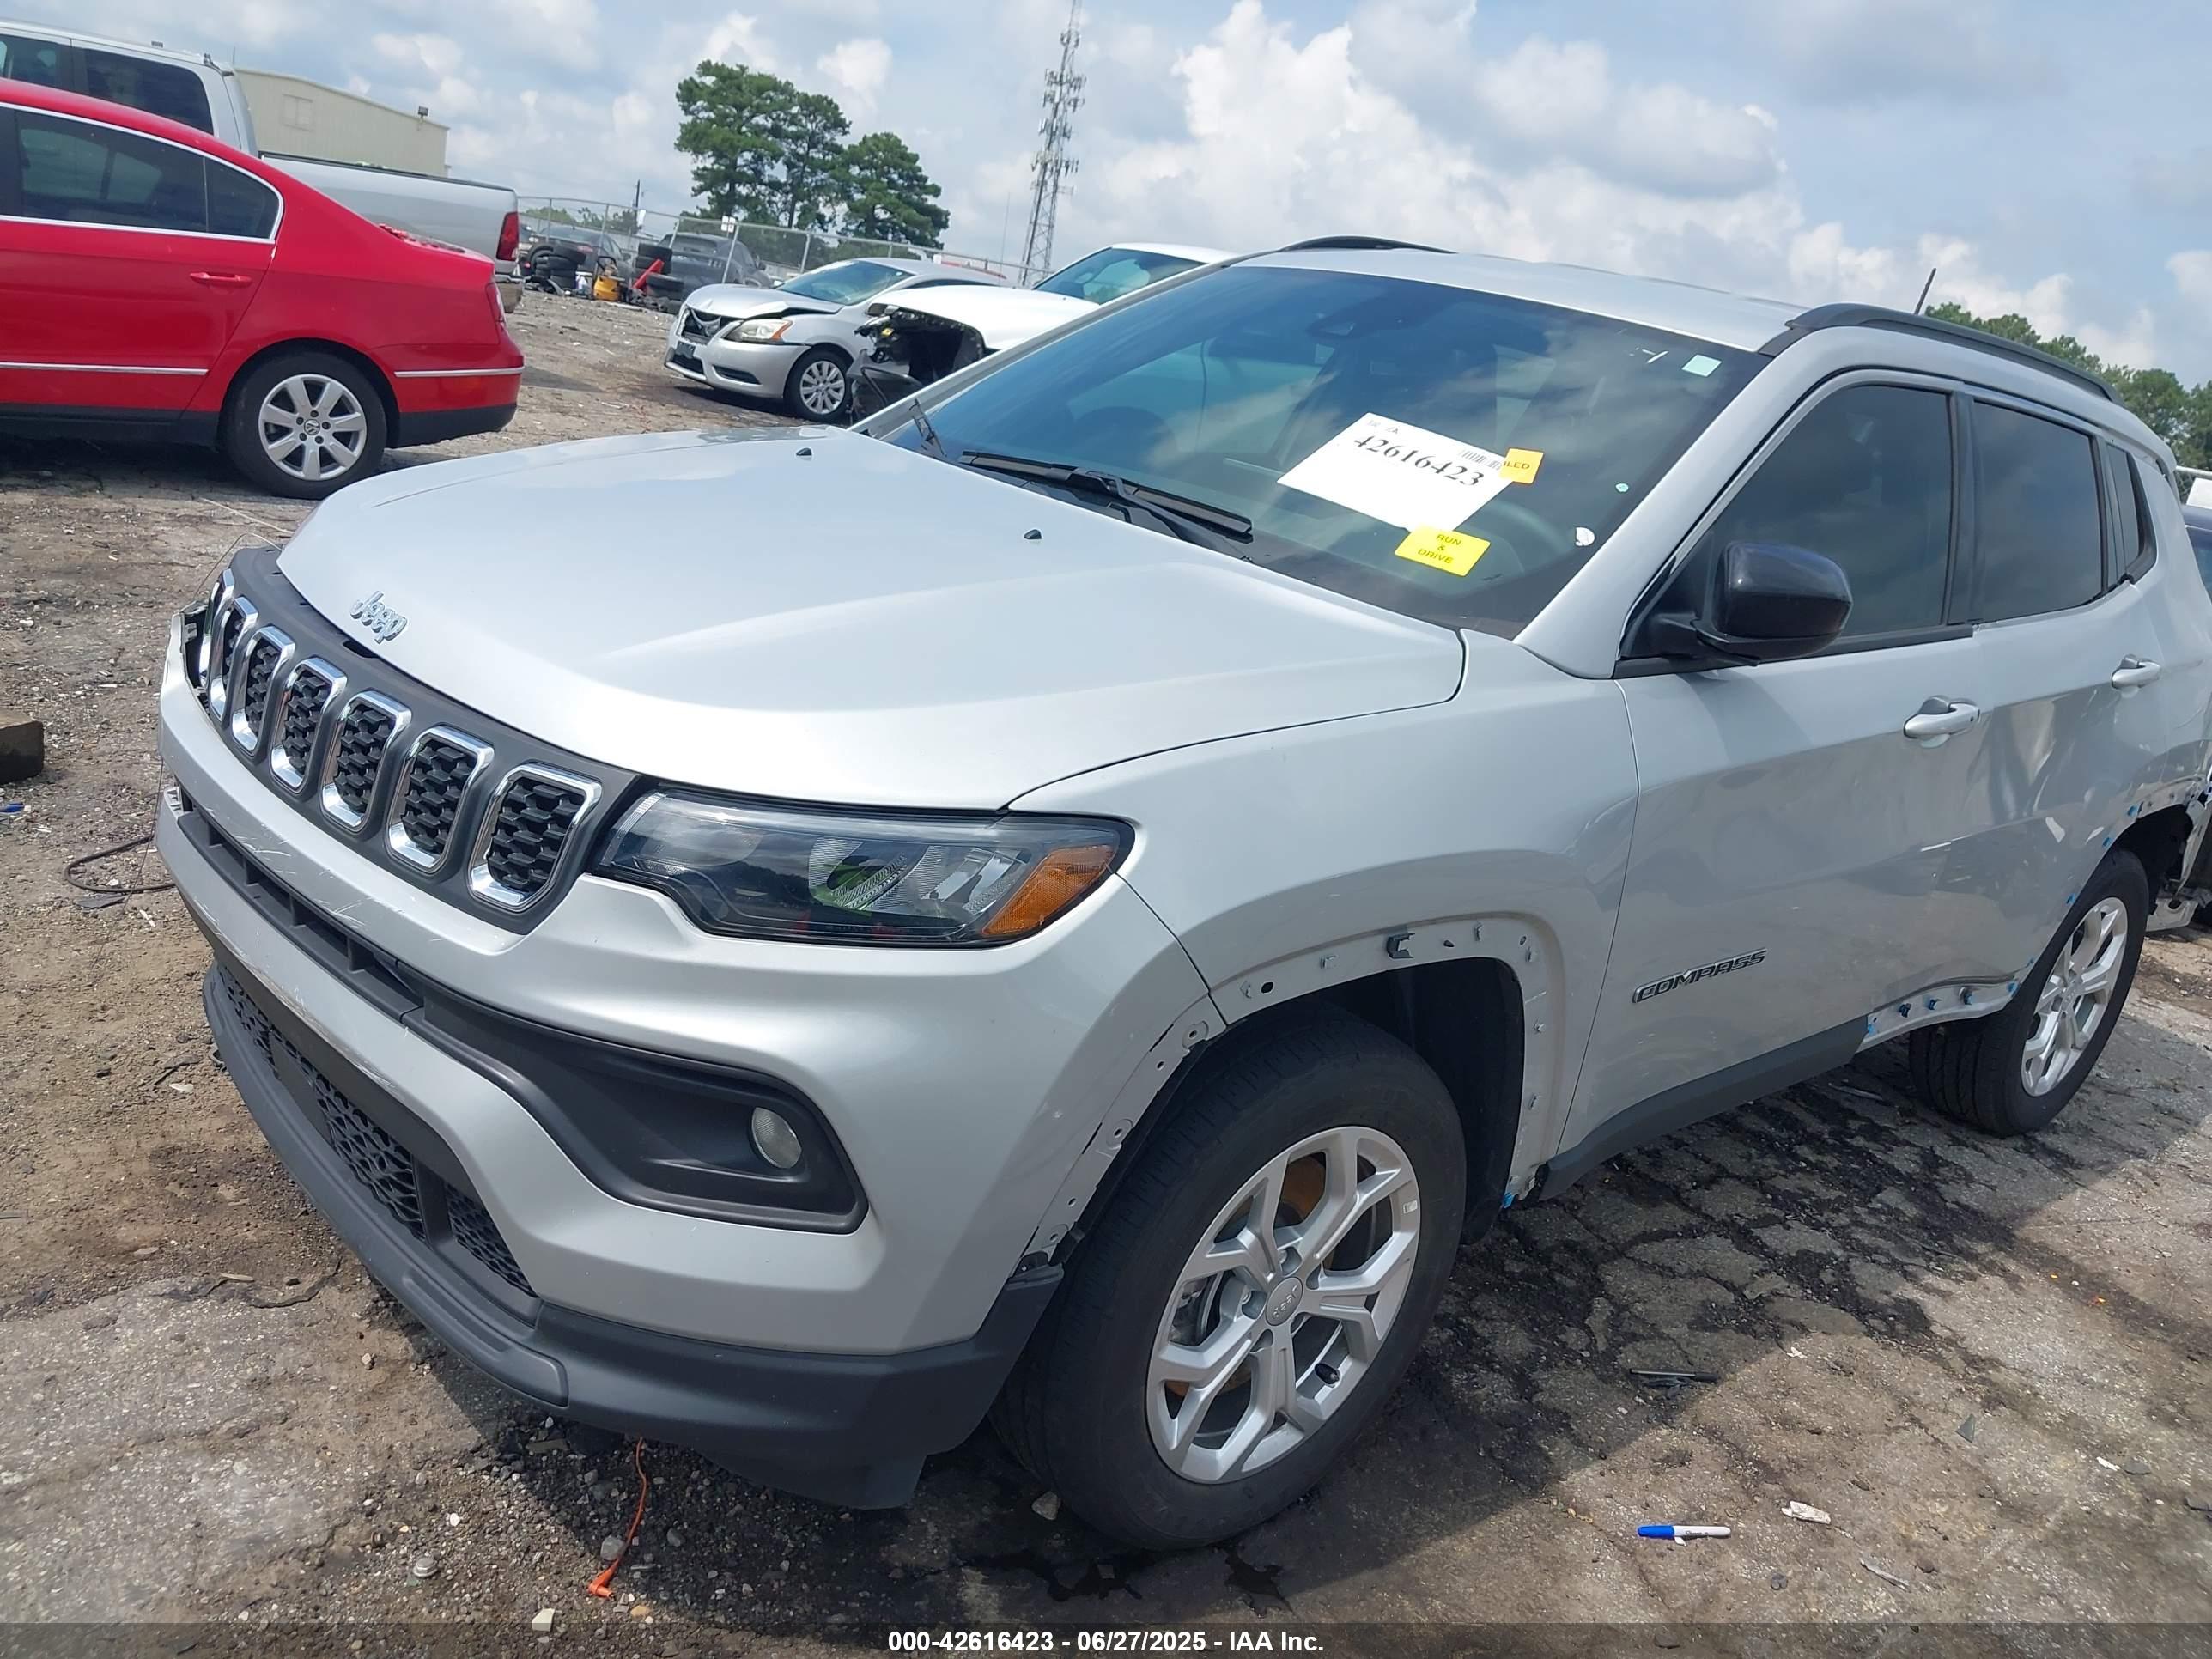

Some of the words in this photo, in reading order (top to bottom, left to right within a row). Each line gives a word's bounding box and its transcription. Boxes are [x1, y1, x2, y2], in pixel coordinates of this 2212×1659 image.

[1354, 435, 1484, 485] 42616423
[1418, 549, 1454, 563] DRIVE
[1436, 534, 1462, 545] RUN
[349, 591, 408, 644] Jeep
[1632, 948, 1767, 1003] COMPASS
